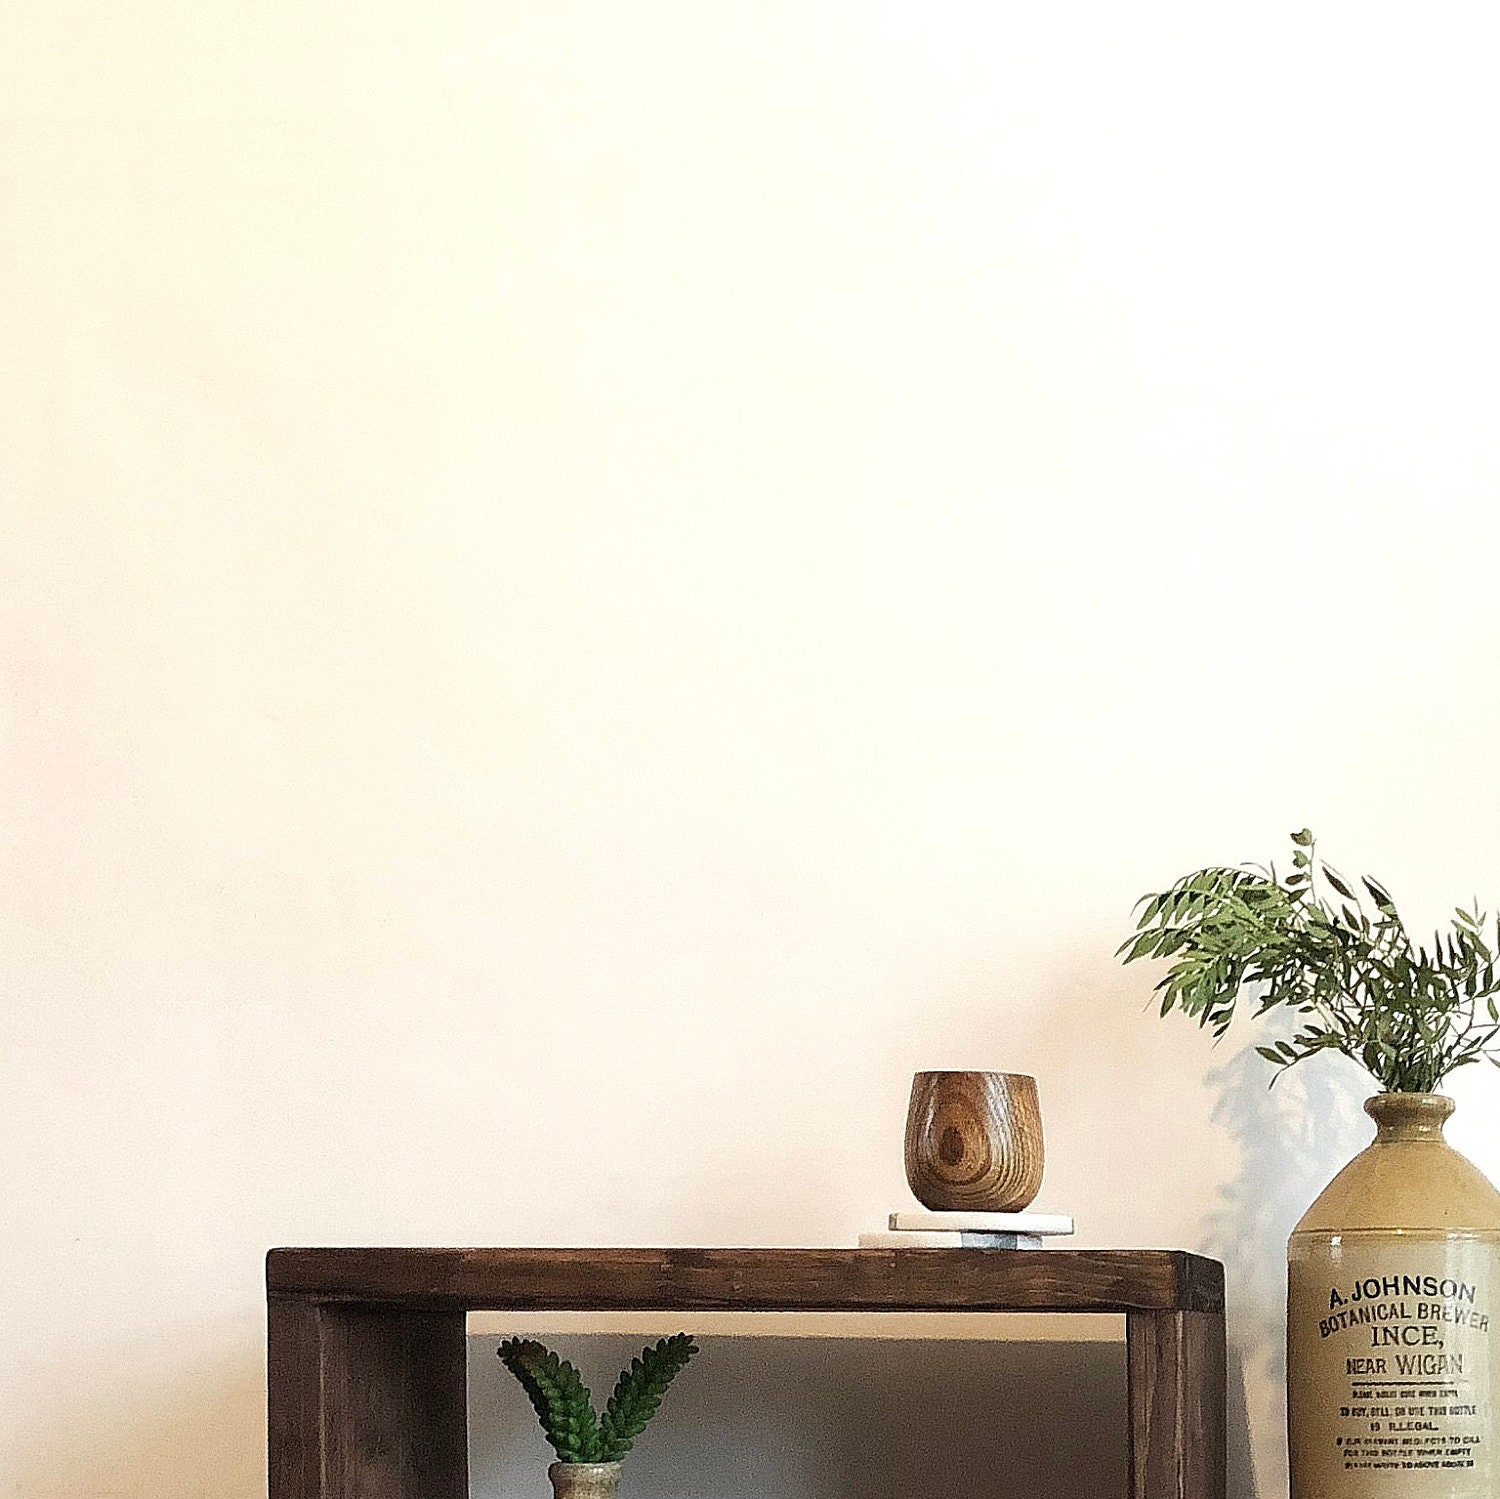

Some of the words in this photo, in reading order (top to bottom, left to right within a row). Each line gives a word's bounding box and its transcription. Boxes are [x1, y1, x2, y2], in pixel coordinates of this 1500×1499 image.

[1352, 1275, 1476, 1304] JOHNSON
[1319, 1302, 1412, 1338] BOTANICAL
[1418, 1302, 1489, 1332] BREWER
[1371, 1325, 1444, 1348] INCE,
[1346, 1359, 1387, 1375] NEAR
[1395, 1354, 1463, 1375] WIGAN
